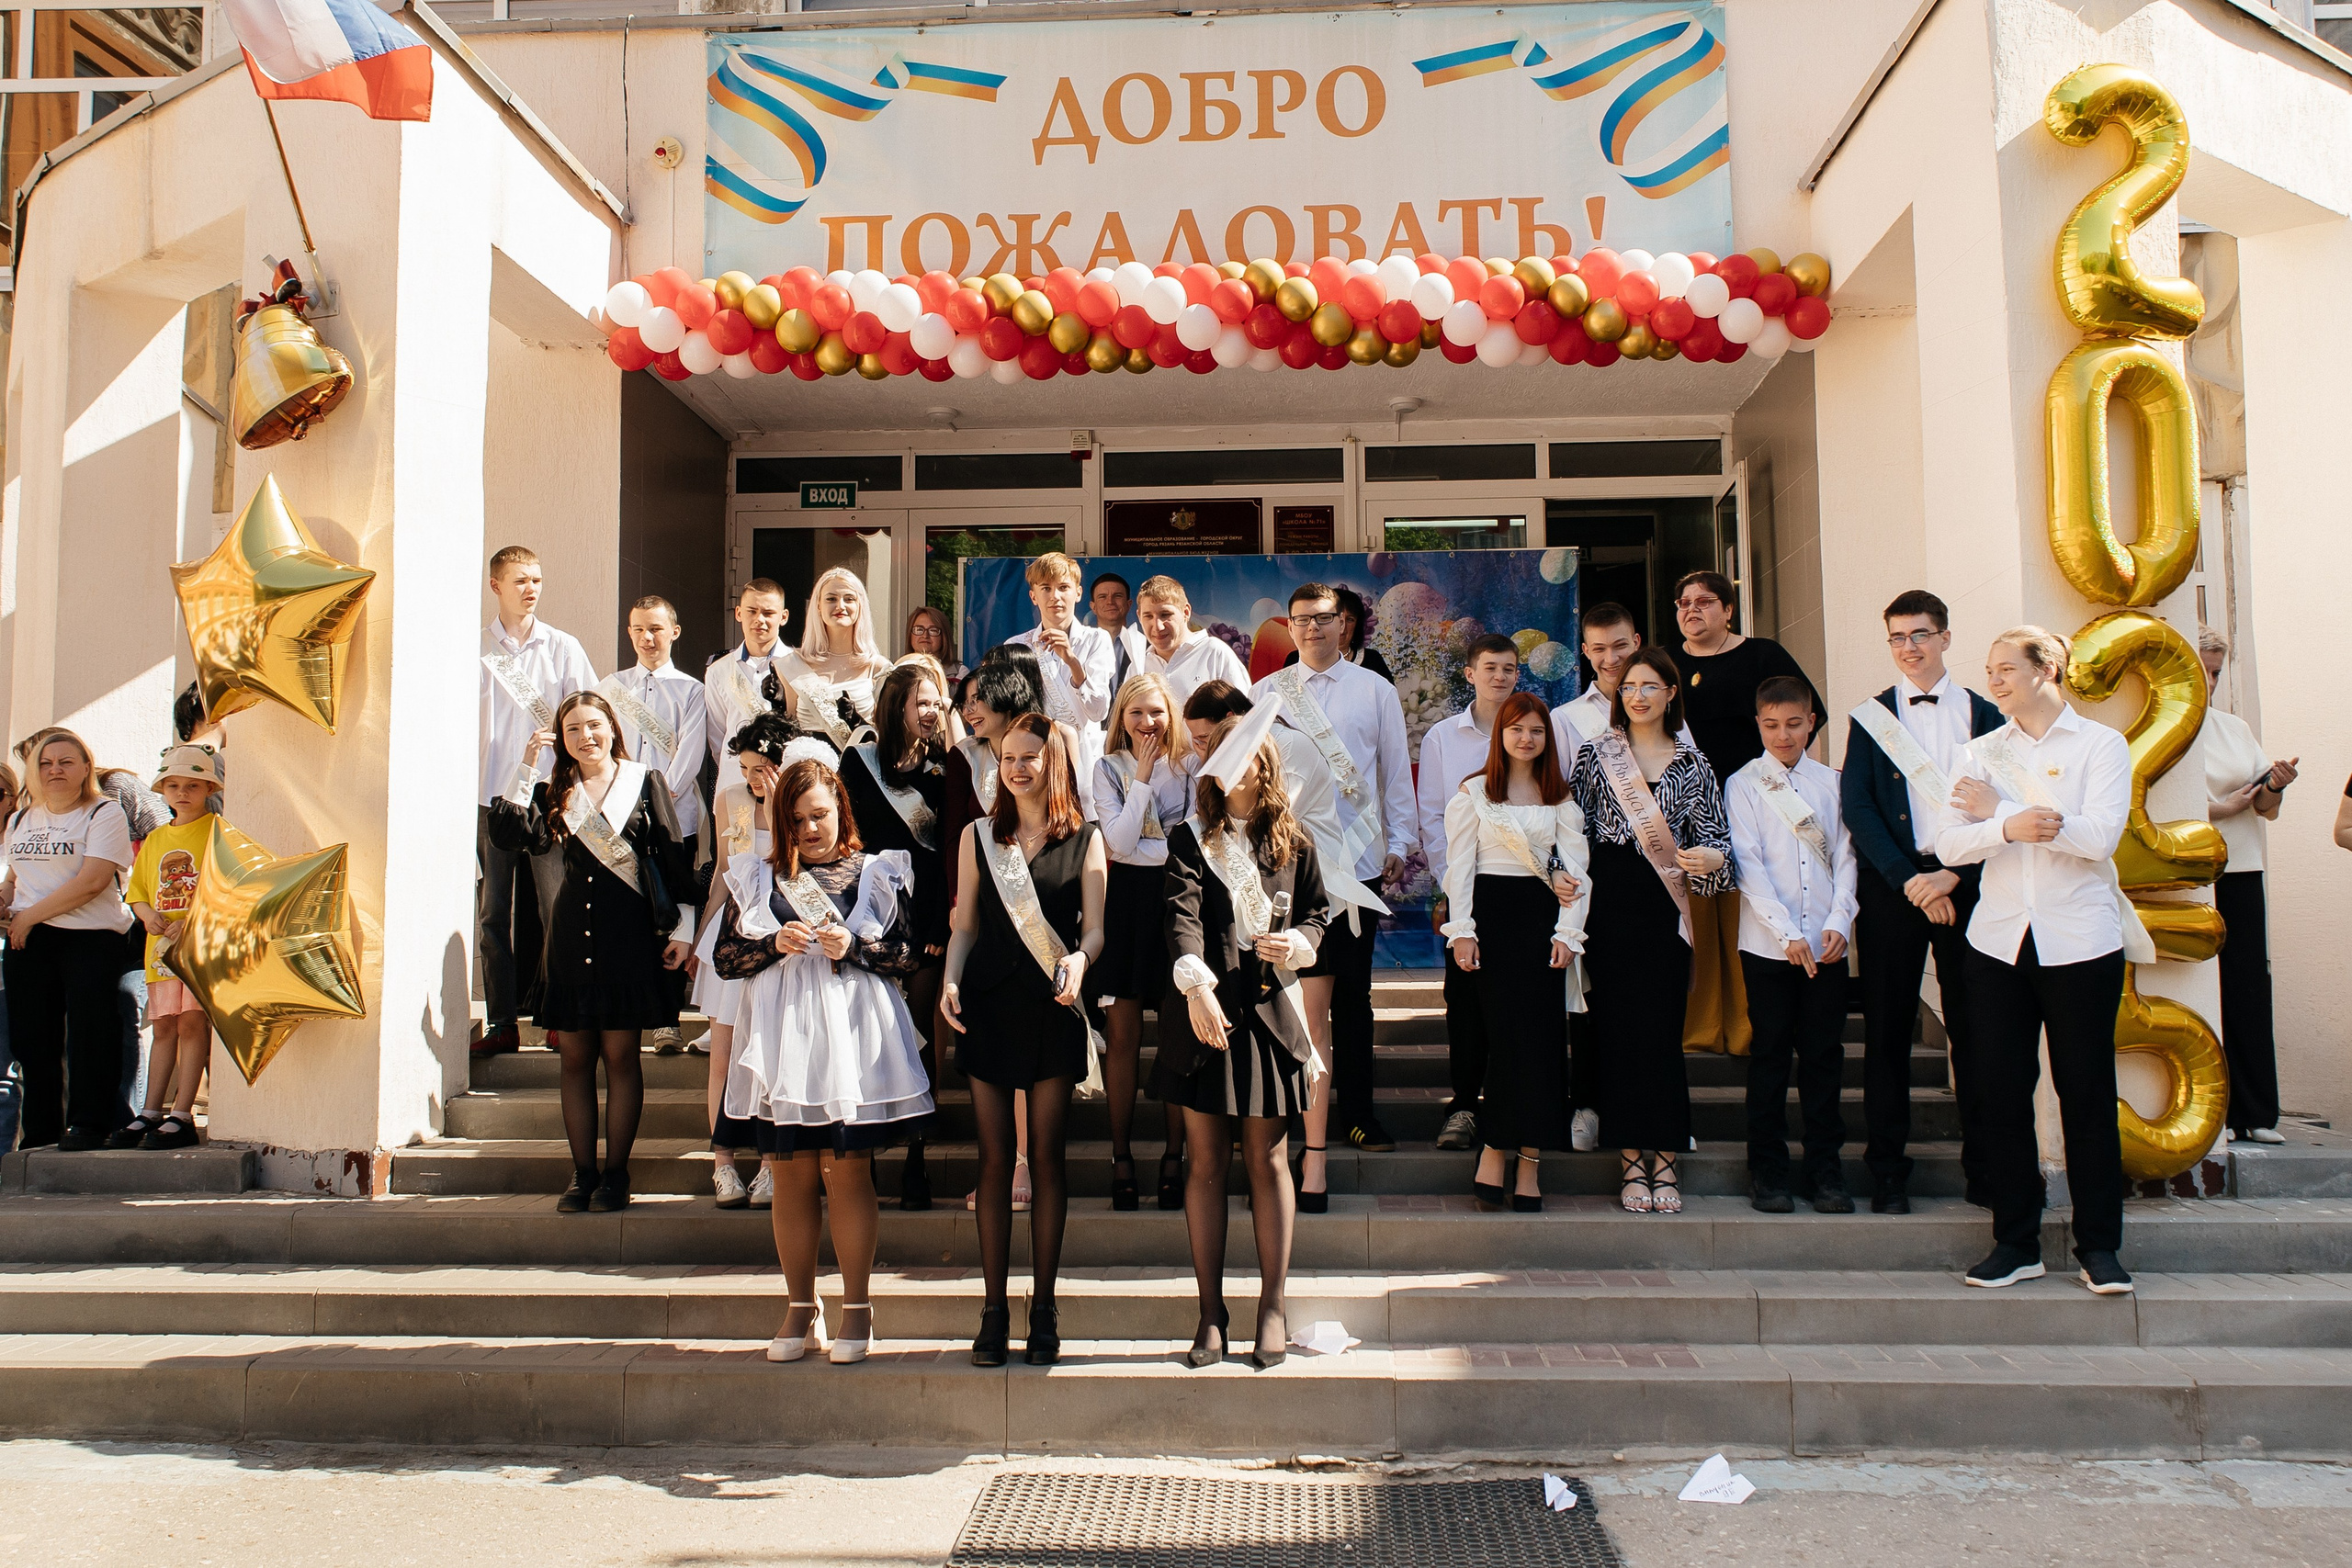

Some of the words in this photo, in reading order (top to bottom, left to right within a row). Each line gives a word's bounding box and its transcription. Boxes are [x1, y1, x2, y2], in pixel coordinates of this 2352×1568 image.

[1032, 65, 1385, 166] ДОБРО
[820, 196, 1607, 280] ПОЖАЛОВАТЬ!
[809, 488, 848, 505] ВХОД
[28, 832, 51, 842] USA
[1611, 759, 1664, 854] Выпускница
[1660, 861, 1687, 898] 2025
